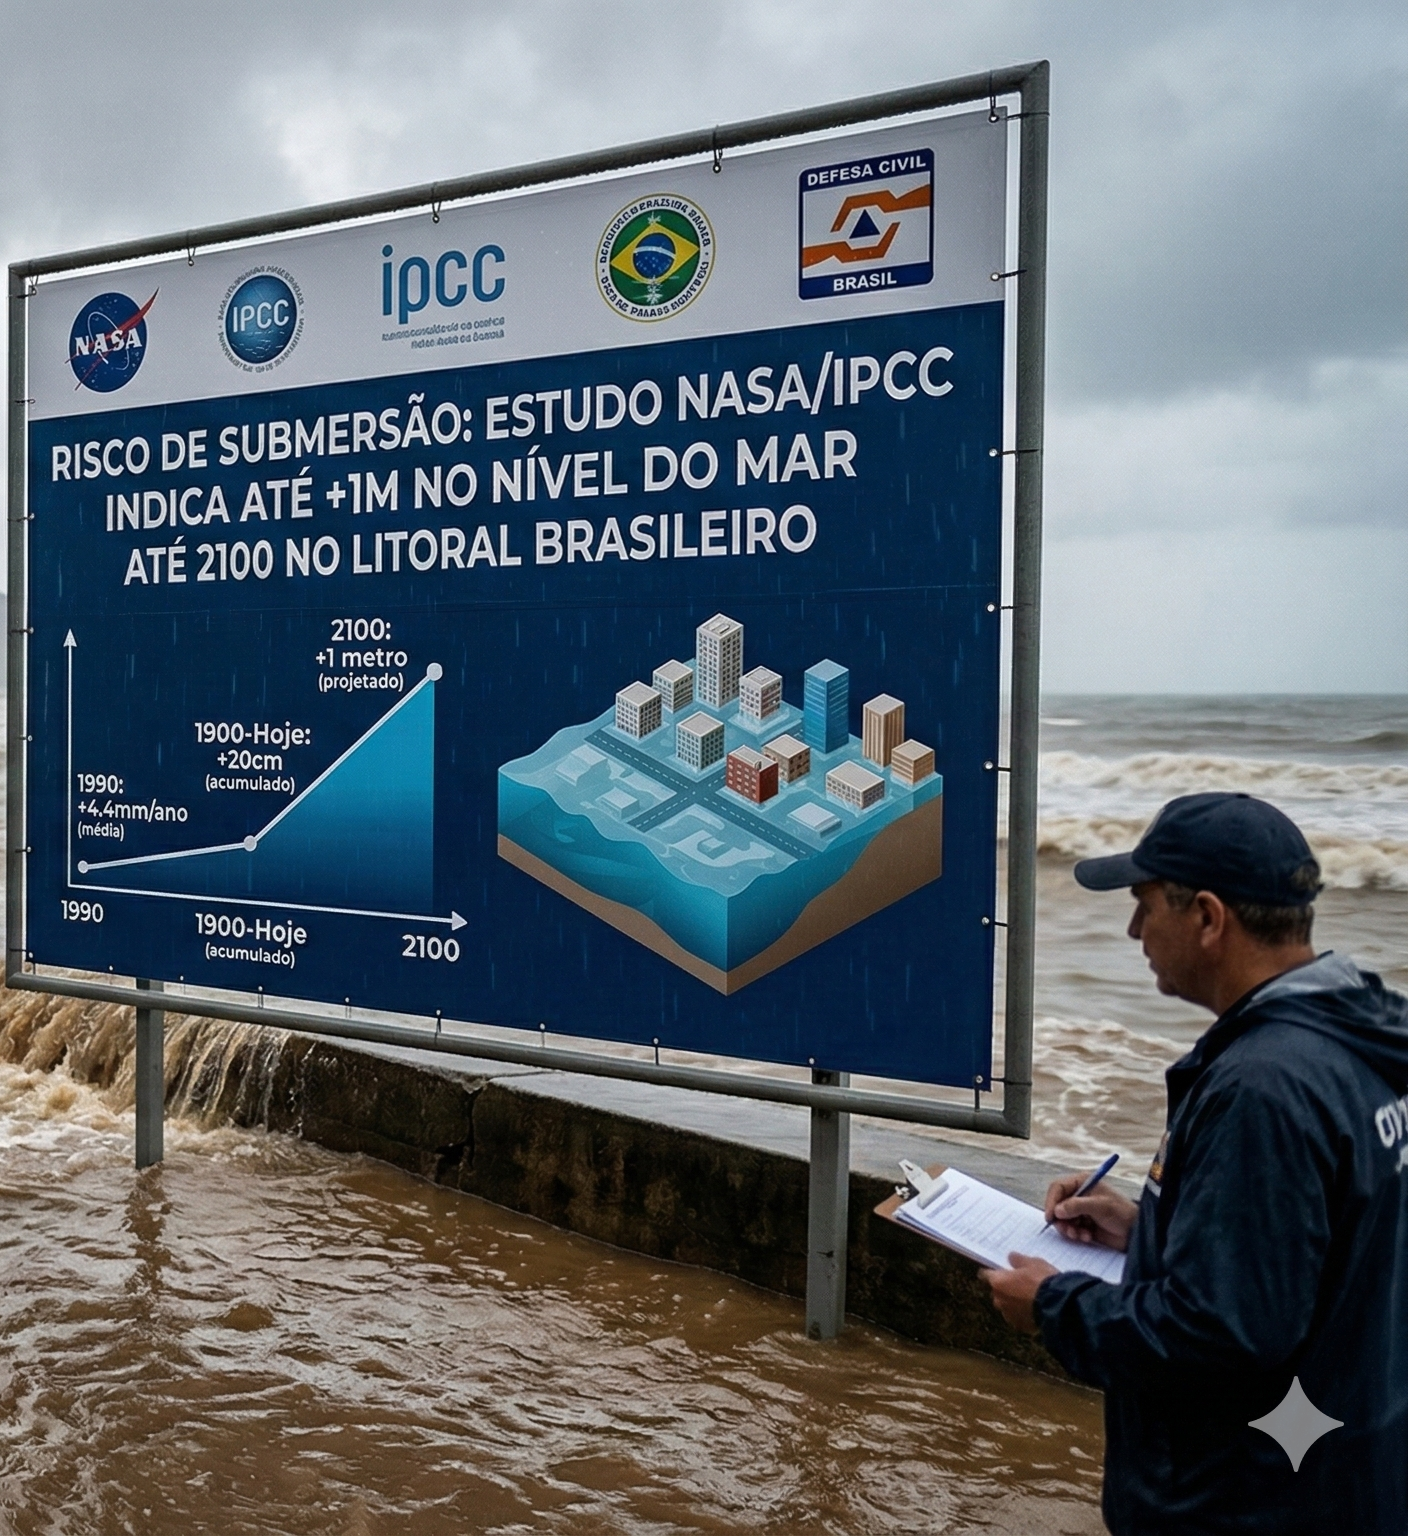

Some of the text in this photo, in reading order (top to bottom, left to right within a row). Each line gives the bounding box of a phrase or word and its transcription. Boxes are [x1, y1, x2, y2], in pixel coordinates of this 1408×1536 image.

[807, 155, 926, 186] DEFESA CIVIL
[382, 244, 505, 324] ipcc
[833, 271, 897, 291] BRASIL
[233, 299, 289, 332] IPCC
[75, 328, 142, 356] NASA
[52, 346, 954, 482] RISCO DE SUBMERSÃO: ESTUDO NASA/IPCC
[106, 429, 858, 532] INDICA ATÉ +1M NO NÍVEL DO MAR
[123, 504, 817, 586] ATÉ 2100 NO LITORAL BRASILEIRO
[330, 617, 391, 642] 2100:
[315, 647, 408, 668] +1 metro
[318, 671, 404, 693] (projetado)
[194, 720, 311, 750] 1900-Hoje:
[217, 749, 283, 771] +20cm
[77, 773, 124, 794] 1990:
[205, 773, 295, 796] (acumulado)
[77, 798, 188, 823] +4.4mm/ano
[77, 820, 125, 842] (média)
[60, 899, 104, 923] 1990
[195, 912, 307, 946] 1900-Hoje
[205, 941, 295, 969] (acumulado)
[401, 934, 460, 962] 2100
